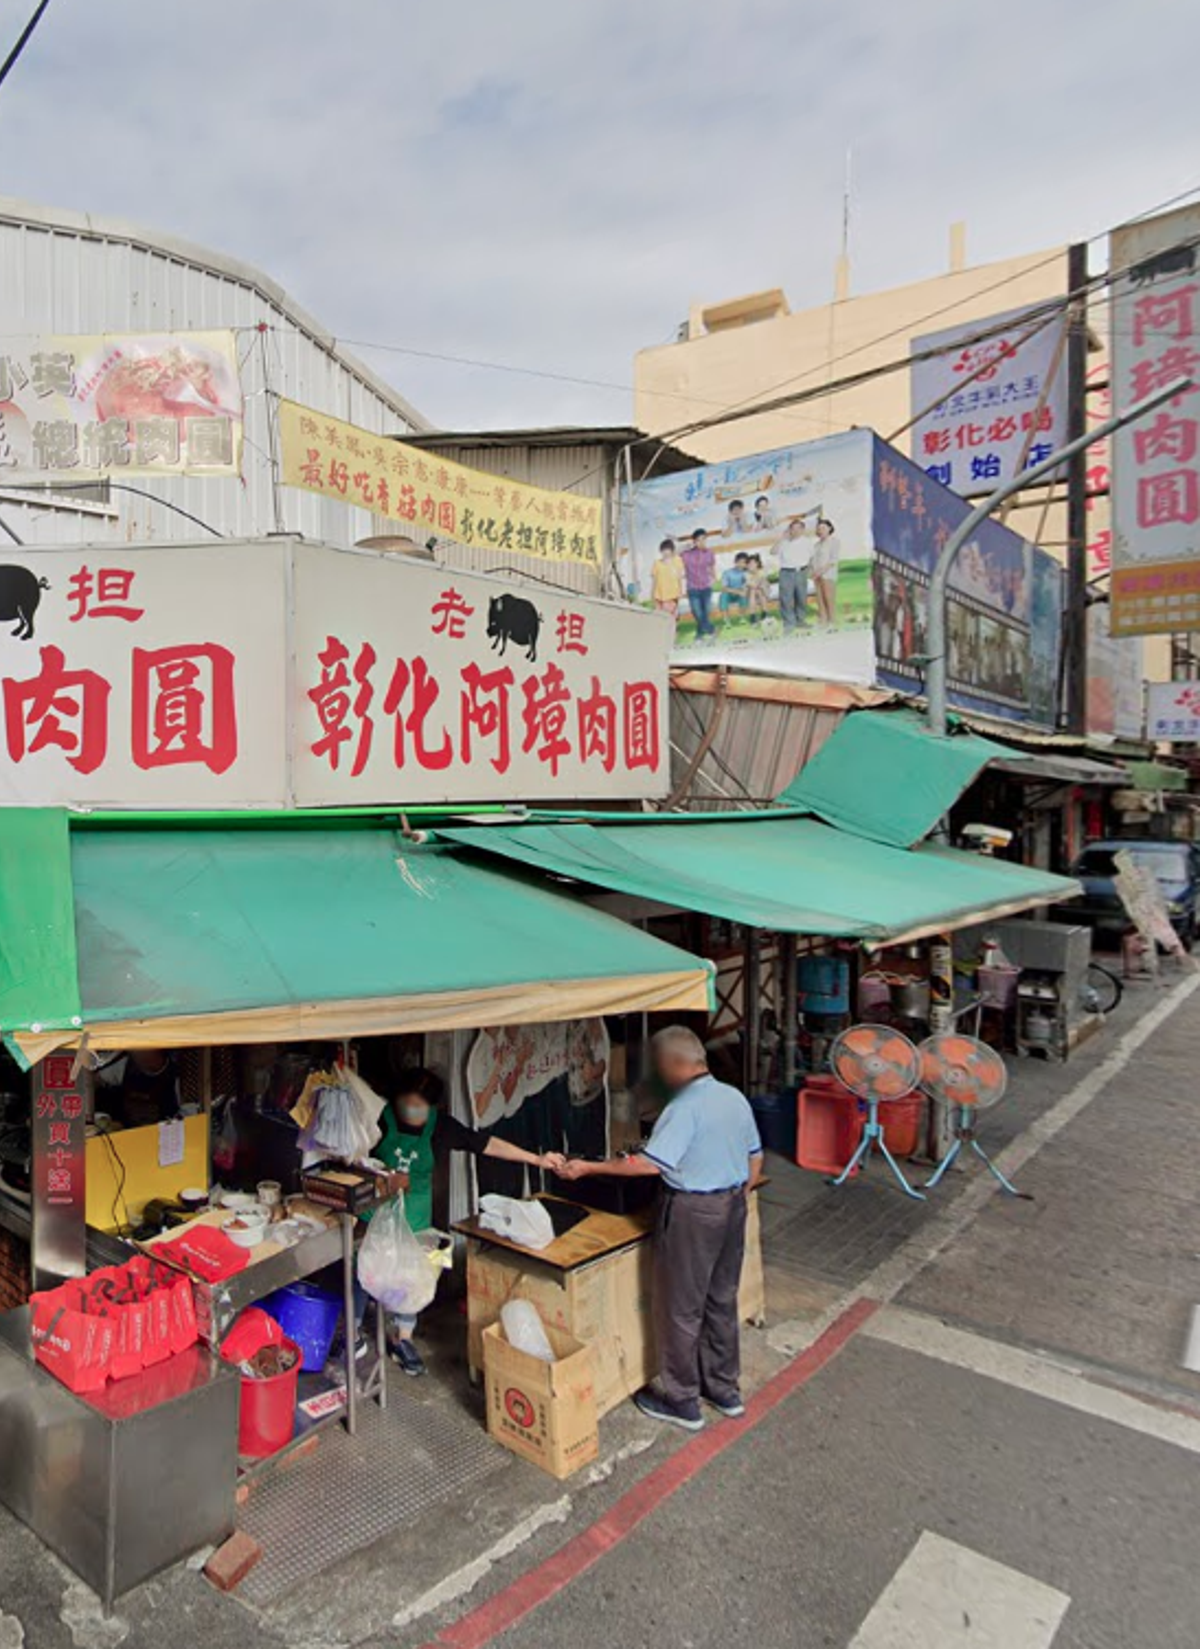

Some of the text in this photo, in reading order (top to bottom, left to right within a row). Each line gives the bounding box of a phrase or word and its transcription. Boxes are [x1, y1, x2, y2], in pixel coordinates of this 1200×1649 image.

[67, 565, 145, 623] 担
[431, 587, 589, 656] 老 担
[307, 635, 660, 777] 彰化阿璋肉圓
[36, 1093, 83, 1119] 外帶
